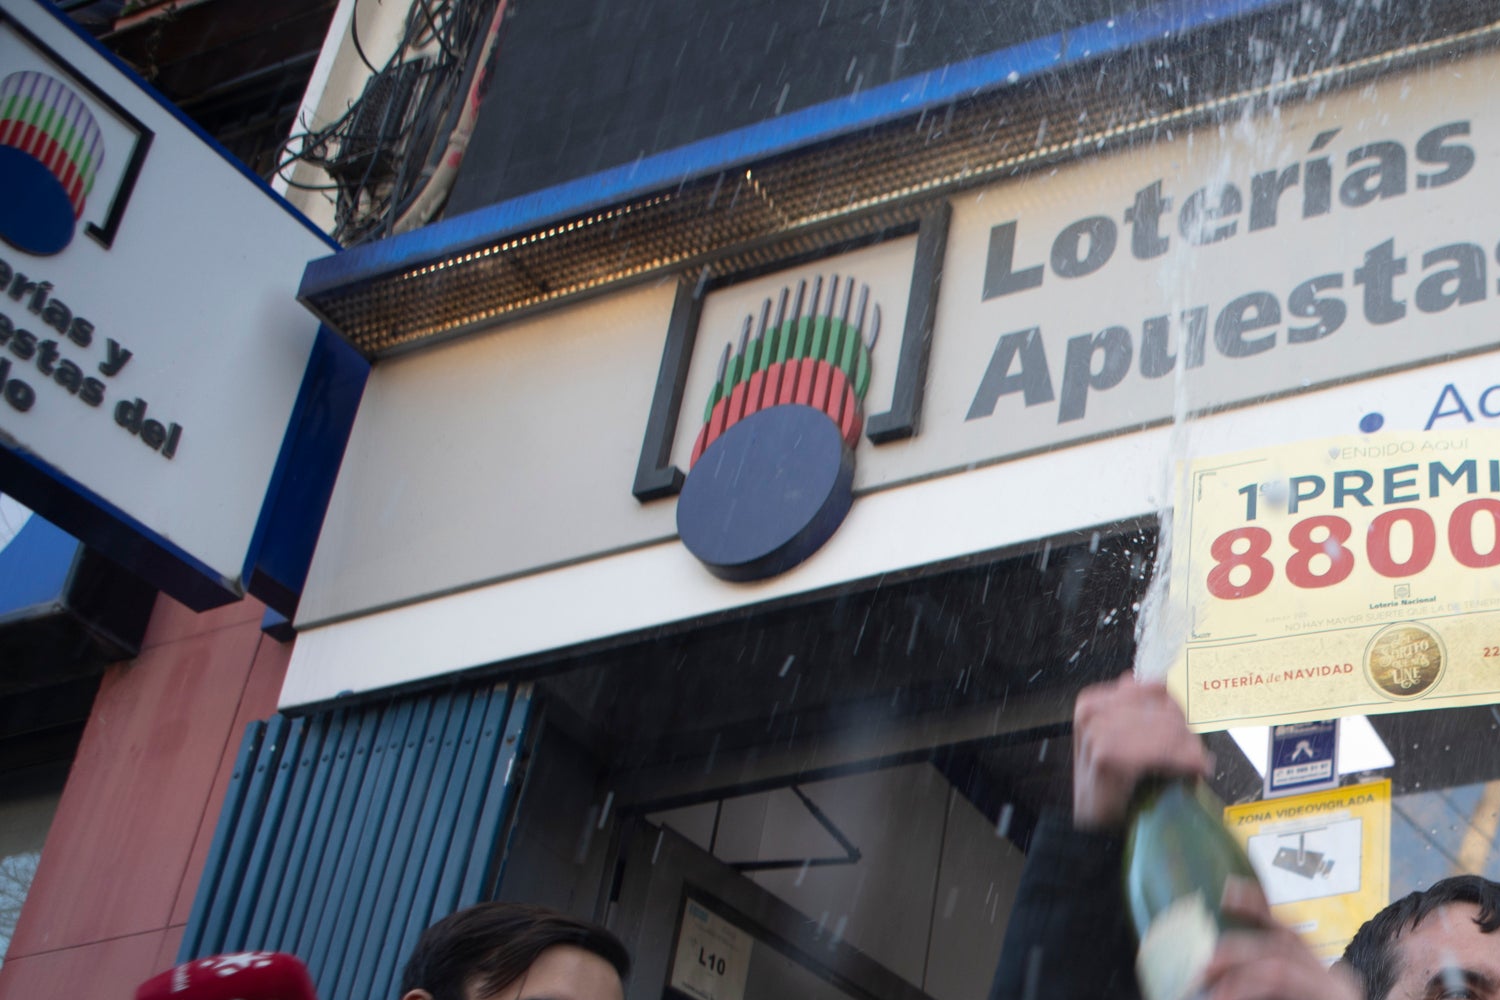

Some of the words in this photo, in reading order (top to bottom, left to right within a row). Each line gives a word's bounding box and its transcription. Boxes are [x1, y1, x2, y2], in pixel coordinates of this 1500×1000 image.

[982, 120, 1476, 302] Loterías
[98, 338, 133, 377] y
[114, 397, 183, 460] del
[1284, 622, 1300, 632] NO
[1303, 620, 1324, 630] HAY
[1326, 616, 1363, 627] MAYOR
[1366, 609, 1404, 621] SUERTE
[1483, 646, 1500, 657] 22
[1203, 672, 1264, 690] LOTERÍA
[1266, 672, 1281, 684] de
[1284, 663, 1353, 681] NAVIDAD
[1238, 812, 1272, 827] ZONA
[1276, 793, 1375, 818] VIDEOVIGILADA
[698, 946, 726, 976] L10
